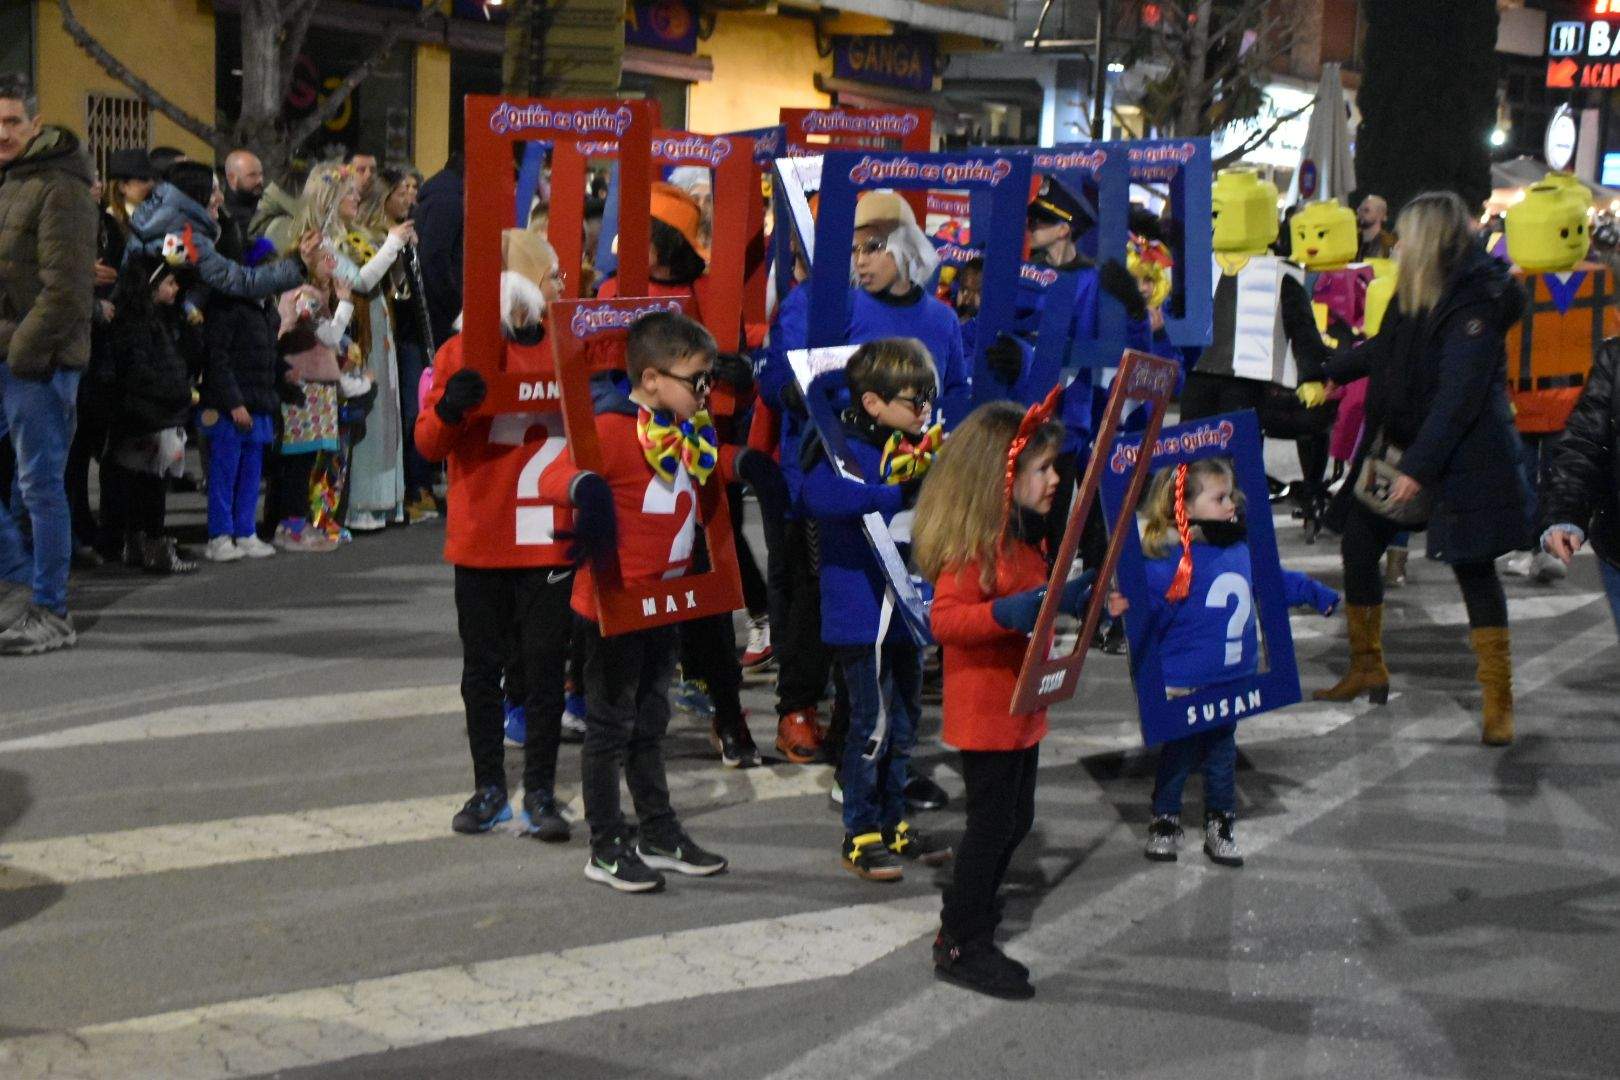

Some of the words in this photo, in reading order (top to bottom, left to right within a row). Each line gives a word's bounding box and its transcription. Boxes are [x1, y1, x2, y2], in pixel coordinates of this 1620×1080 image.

[848, 37, 922, 77] GANGA
[490, 102, 552, 133] ¿Quién
[573, 107, 632, 137] Quién?
[663, 136, 731, 165] Quién?
[849, 156, 918, 184] ¿Quién
[919, 164, 941, 181] es
[942, 158, 1011, 187] Quién?
[571, 304, 620, 337] ¿Quién
[519, 380, 560, 401] DAN
[1181, 420, 1234, 454] Quién?
[642, 590, 696, 616] MAX
[1187, 688, 1261, 726] SUSAN
